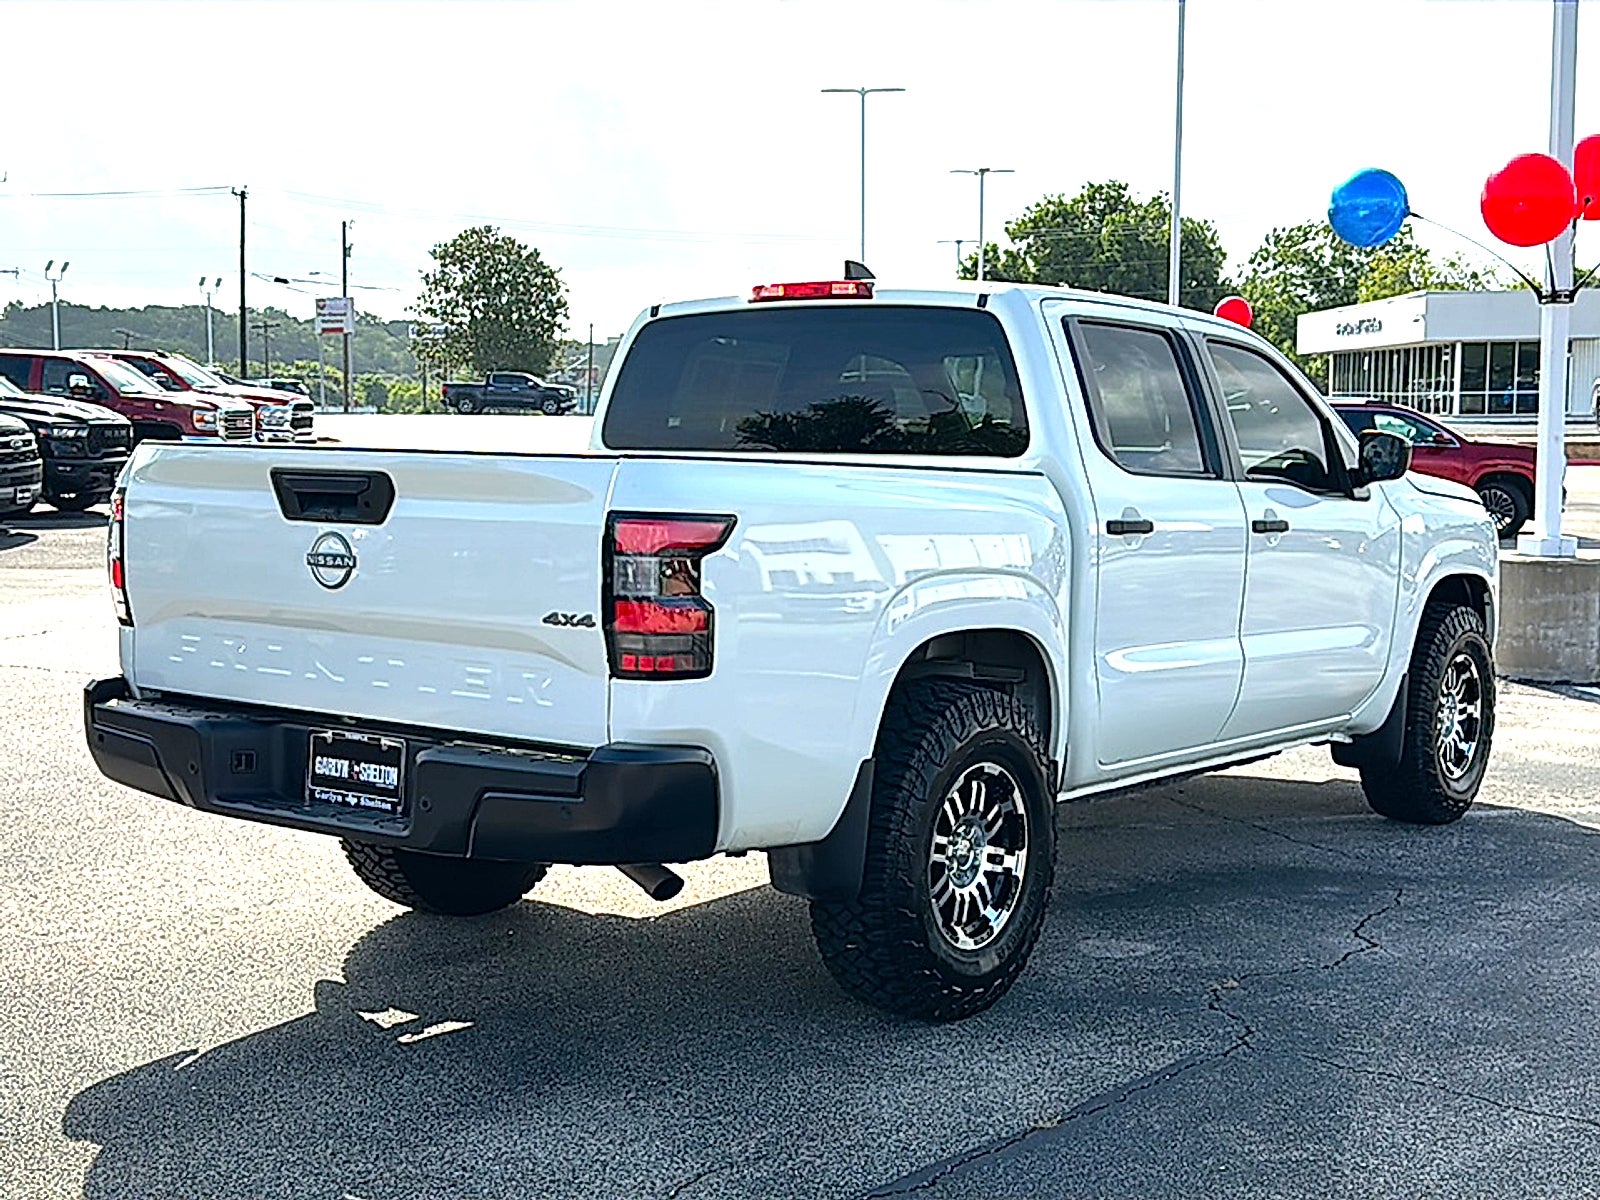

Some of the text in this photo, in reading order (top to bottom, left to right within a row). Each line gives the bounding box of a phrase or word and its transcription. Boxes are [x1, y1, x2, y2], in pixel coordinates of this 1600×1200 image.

[308, 554, 354, 567] NISSAN
[168, 633, 554, 707] FRONTIER
[315, 755, 398, 786] GARLYN SHELTON
